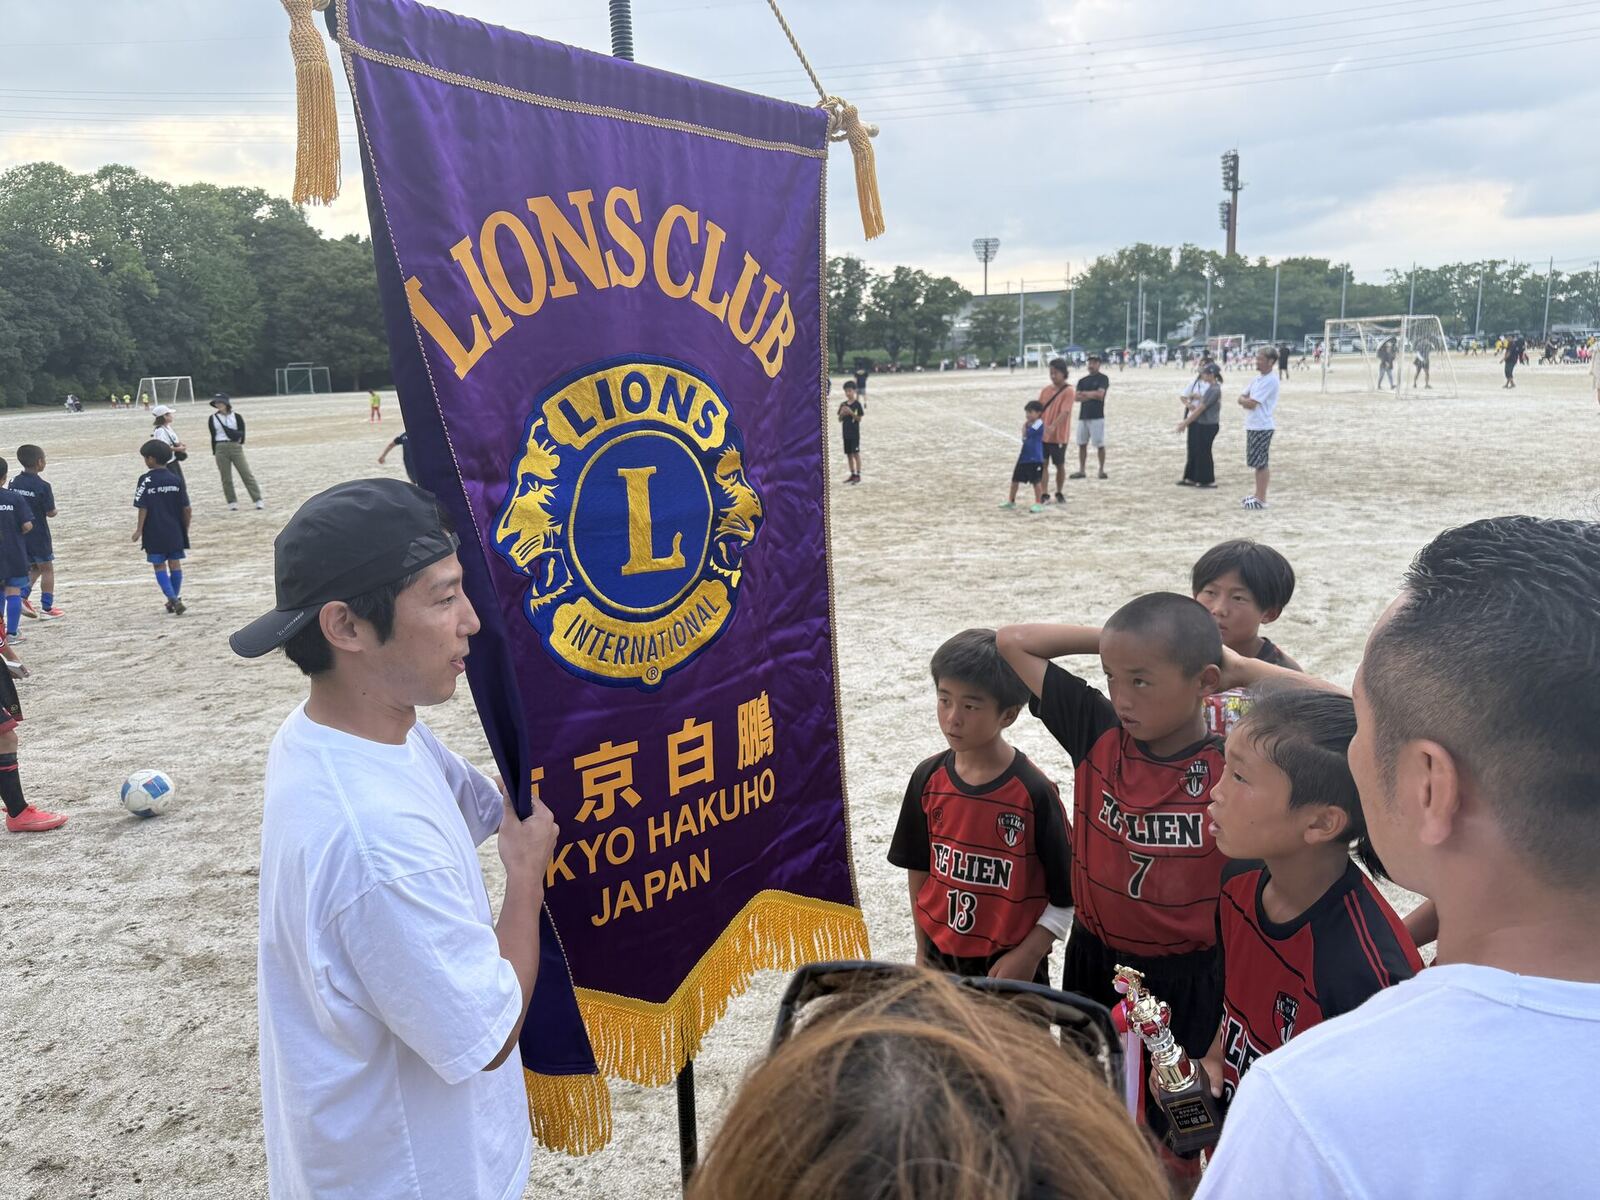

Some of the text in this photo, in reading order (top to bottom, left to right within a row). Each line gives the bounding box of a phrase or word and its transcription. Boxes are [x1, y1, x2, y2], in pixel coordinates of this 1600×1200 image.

[404, 185, 797, 381] LIONS CLUB
[558, 370, 720, 439] LIONS
[617, 465, 686, 576] L
[562, 594, 720, 665] INTERNATIONAL
[531, 690, 774, 823] 京白鵬
[546, 767, 776, 888] KYO HAKUHO
[1123, 812, 1203, 847] LIEN
[591, 848, 711, 927] JAPAN
[950, 849, 1013, 890] LIEN
[1128, 851, 1155, 899] 7
[946, 889, 977, 934] 13
